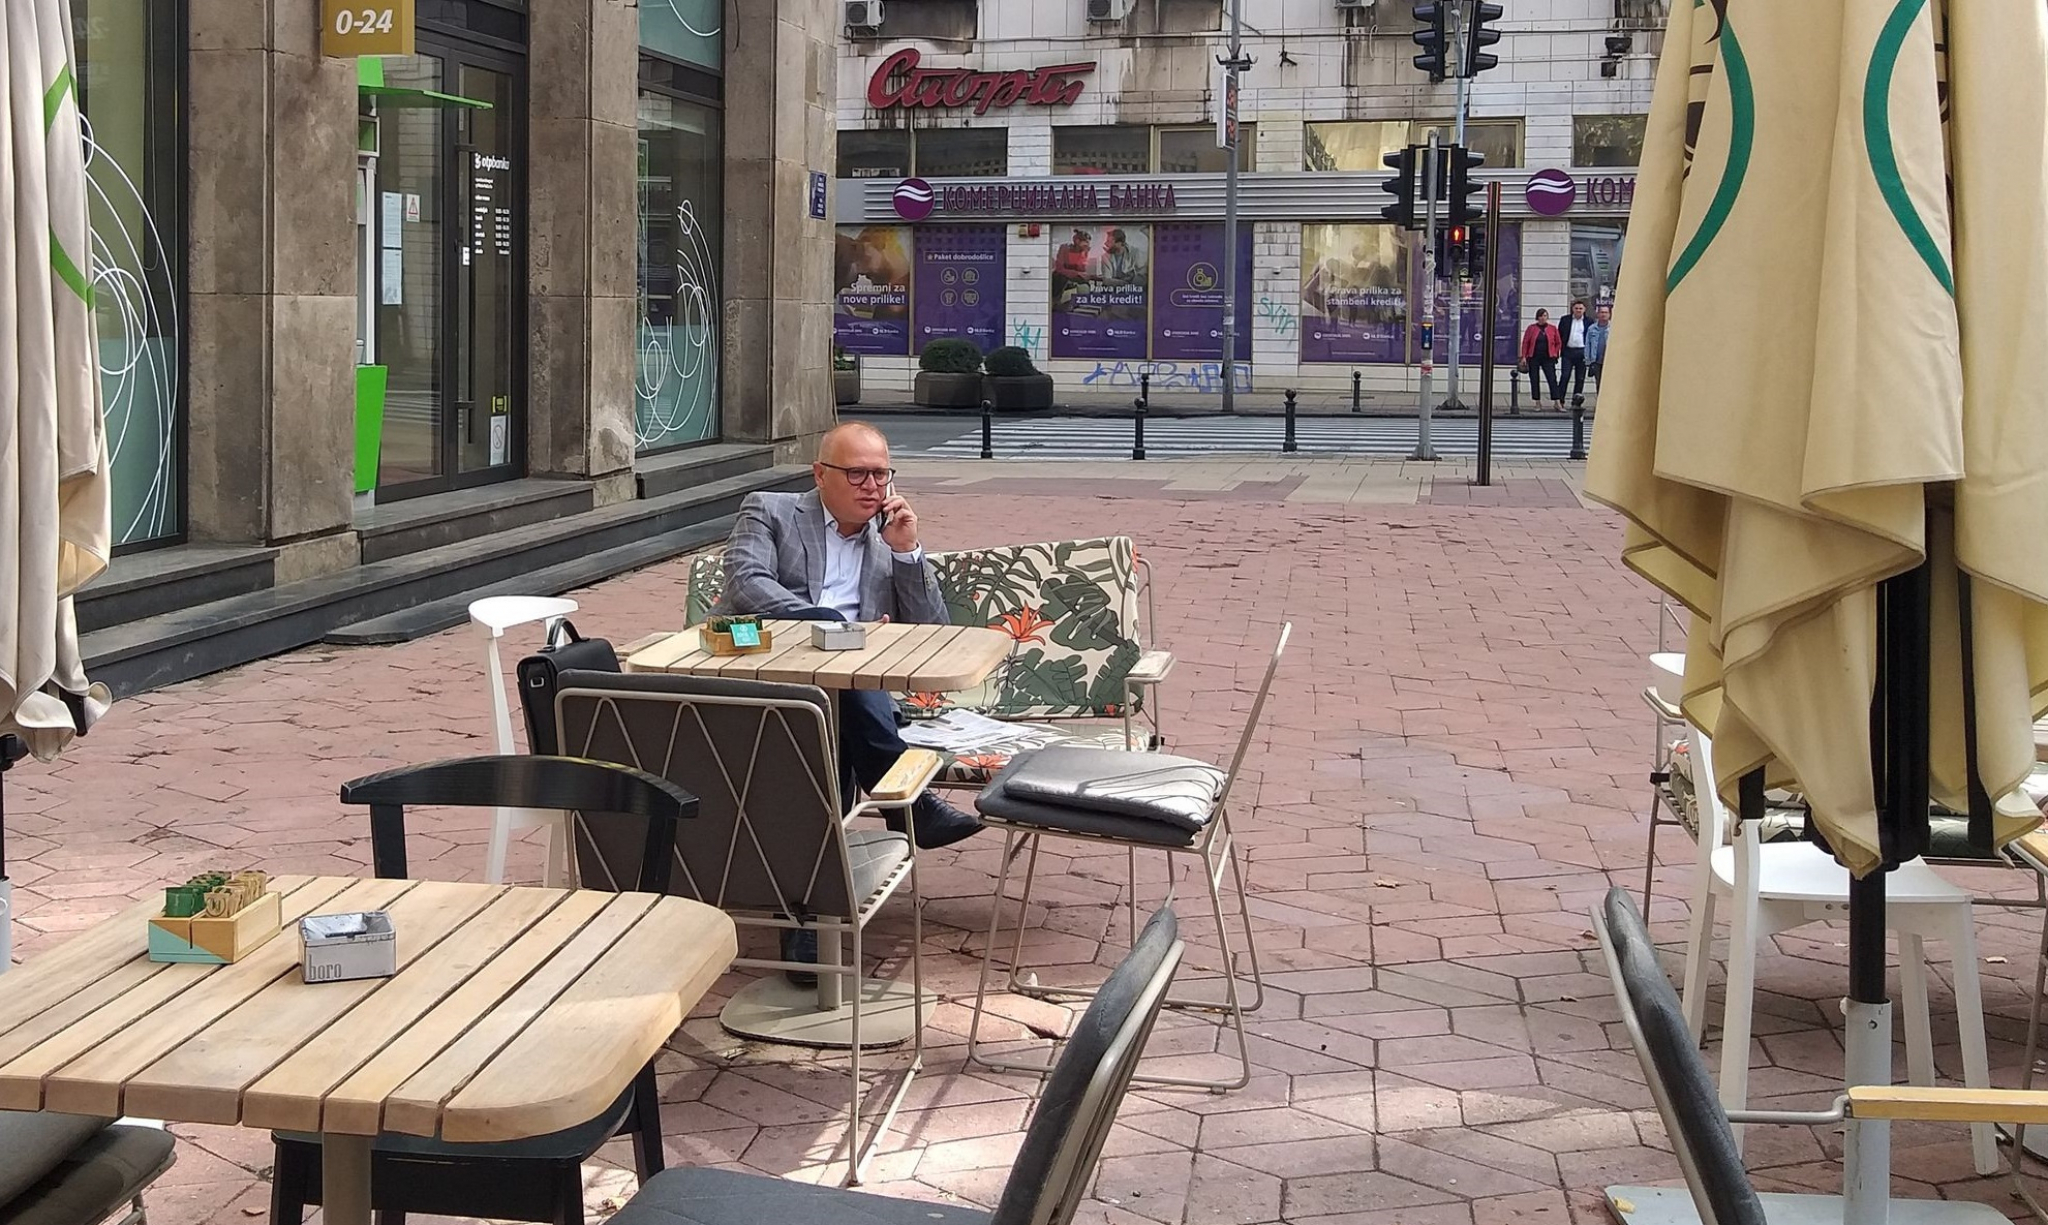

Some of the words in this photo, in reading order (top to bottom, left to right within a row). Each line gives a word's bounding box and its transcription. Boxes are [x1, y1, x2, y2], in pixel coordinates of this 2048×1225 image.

[335, 9, 393, 35] 0-24
[482, 156, 510, 171] otpbanka
[942, 184, 1099, 211] КОМЕРЦИЈАЛНА
[1108, 183, 1178, 210] БАНКА
[850, 283, 892, 295] Spremni
[893, 284, 905, 292] za
[1116, 284, 1143, 294] prilika
[1360, 286, 1389, 297] prilika
[843, 294, 868, 304] nove
[870, 293, 905, 305] prilike!
[1076, 296, 1088, 304] za
[1090, 294, 1107, 304] keš
[1109, 294, 1142, 304] kredit!
[1327, 297, 1369, 306] stambeni
[308, 953, 342, 980] boro
